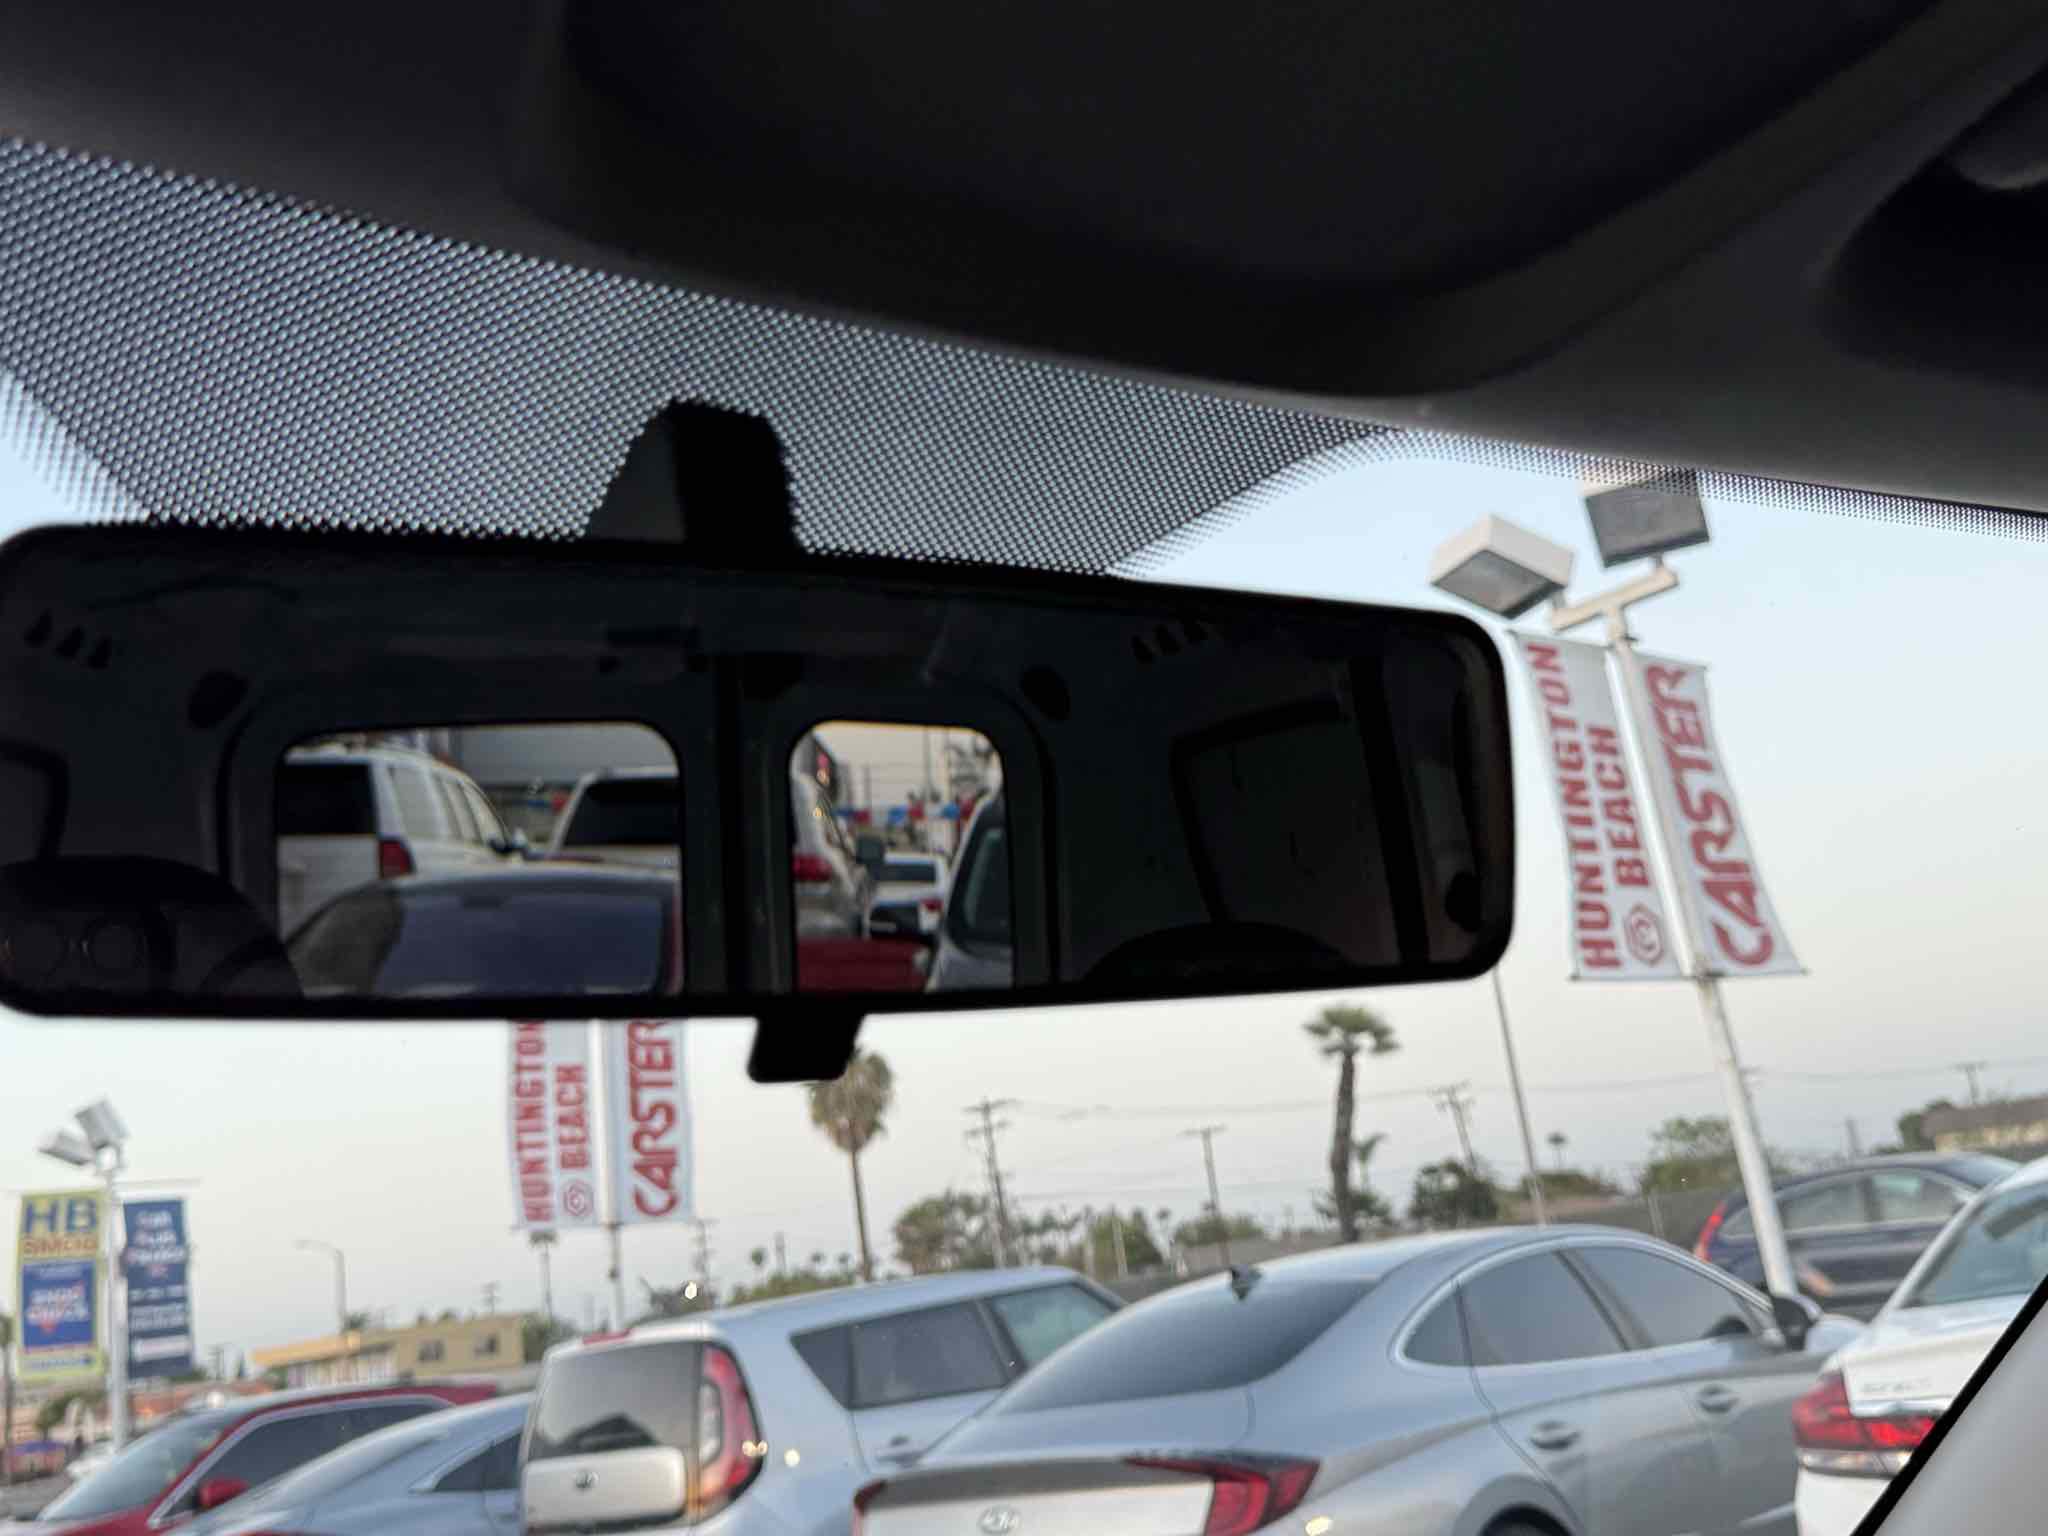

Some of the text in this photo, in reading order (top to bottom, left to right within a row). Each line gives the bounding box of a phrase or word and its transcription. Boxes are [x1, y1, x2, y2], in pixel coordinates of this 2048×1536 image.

[1526, 642, 1622, 969] HUNTINGTON
[1587, 725, 1651, 887] BEACH
[1645, 663, 1774, 966] CARSTER
[555, 1064, 588, 1169] BEACH
[24, 1198, 97, 1233] HB
